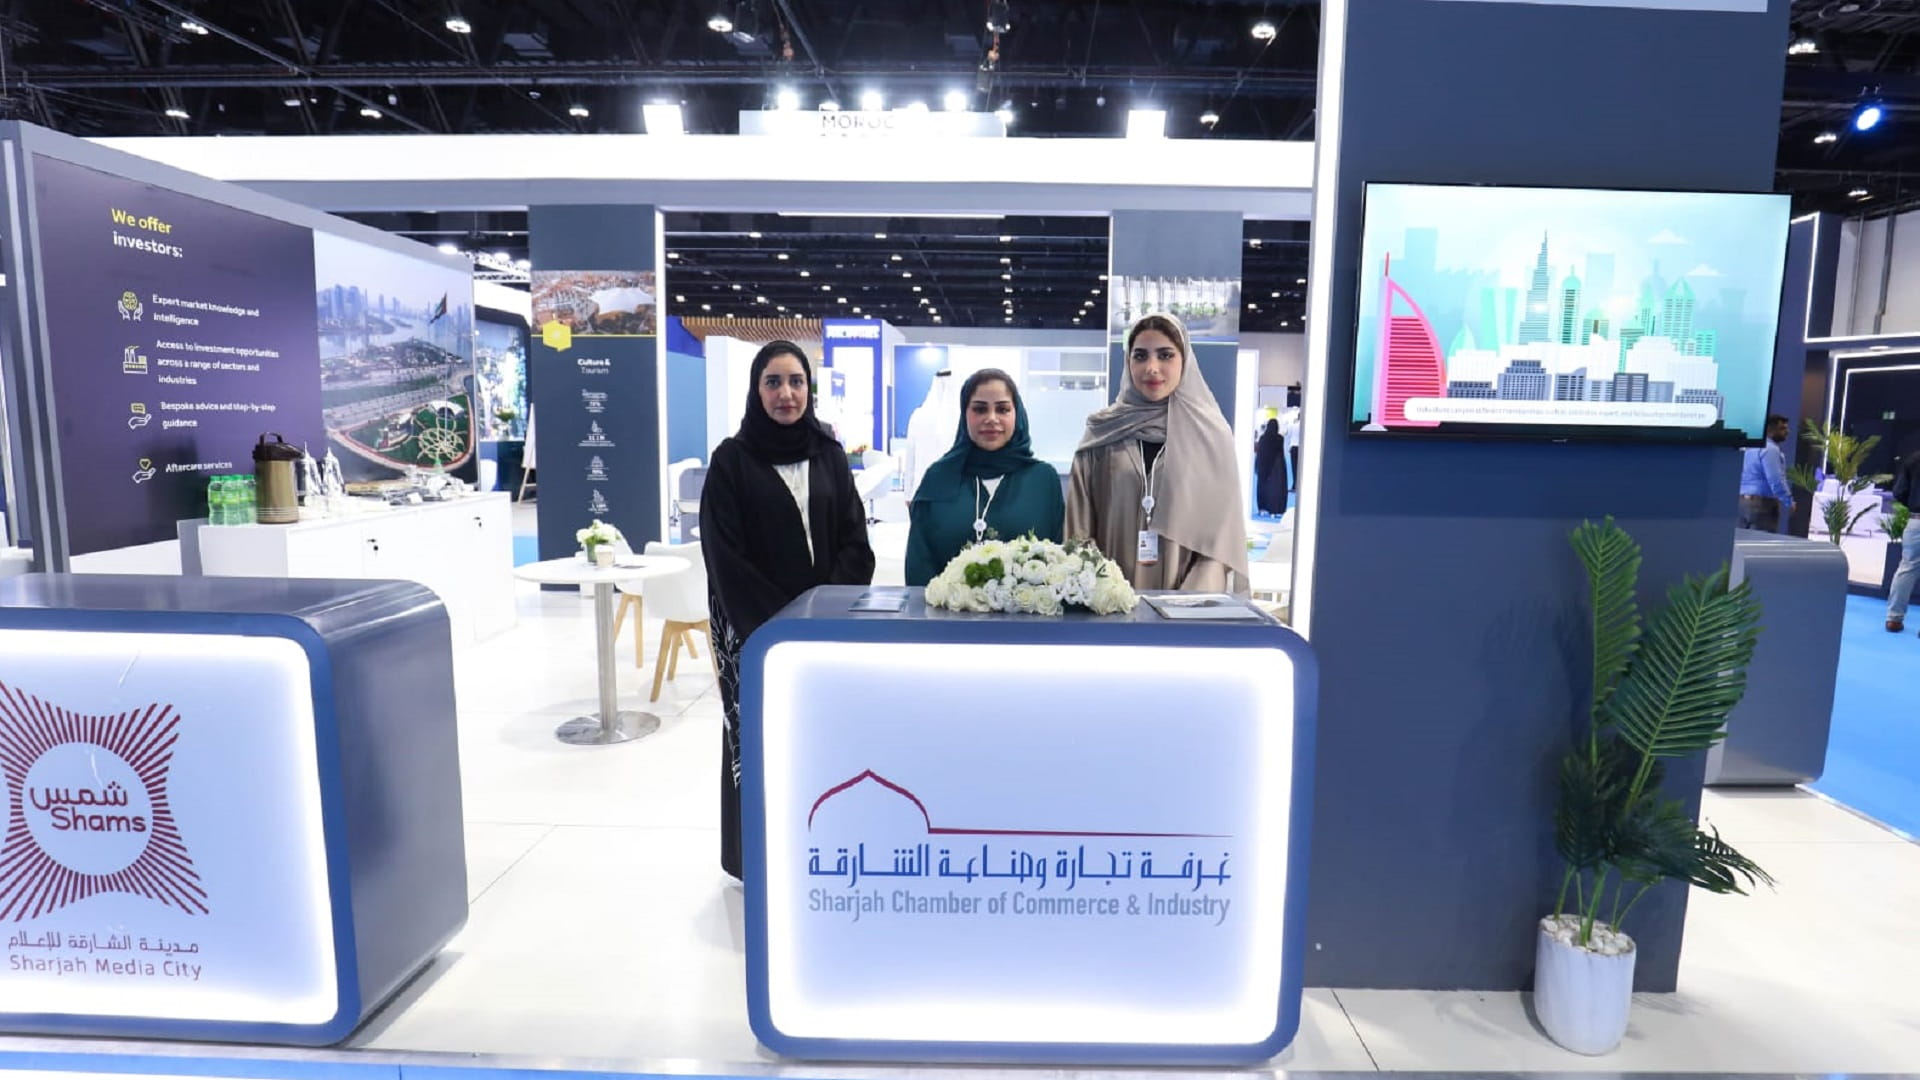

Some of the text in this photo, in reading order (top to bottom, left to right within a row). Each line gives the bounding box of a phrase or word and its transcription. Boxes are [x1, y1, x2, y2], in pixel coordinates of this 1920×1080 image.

[111, 208, 173, 235] We offer
[112, 230, 184, 258] investors:
[152, 294, 260, 317] Expert market knowledge and
[156, 340, 280, 359] Access to investment opportunities
[157, 358, 184, 368] across
[190, 361, 211, 371] range
[212, 360, 221, 370] of
[221, 362, 247, 372] sectors
[247, 363, 260, 372] and
[577, 358, 604, 367] Culture
[158, 375, 198, 385] industries
[160, 401, 276, 413] Bespoke advice and step-by-step
[162, 419, 198, 431] guidance
[165, 461, 233, 473] Aftercare services
[29, 780, 129, 812] شمس
[49, 806, 148, 834] Shams
[808, 842, 1232, 892] غرفة تجارة وصناعة الشارقة
[808, 889, 1231, 927] Sharjah Chamber of Commerce & Industry
[7, 929, 200, 957] مدينة الشارقة للإعلام
[9, 955, 202, 982] Sharjah Media City
